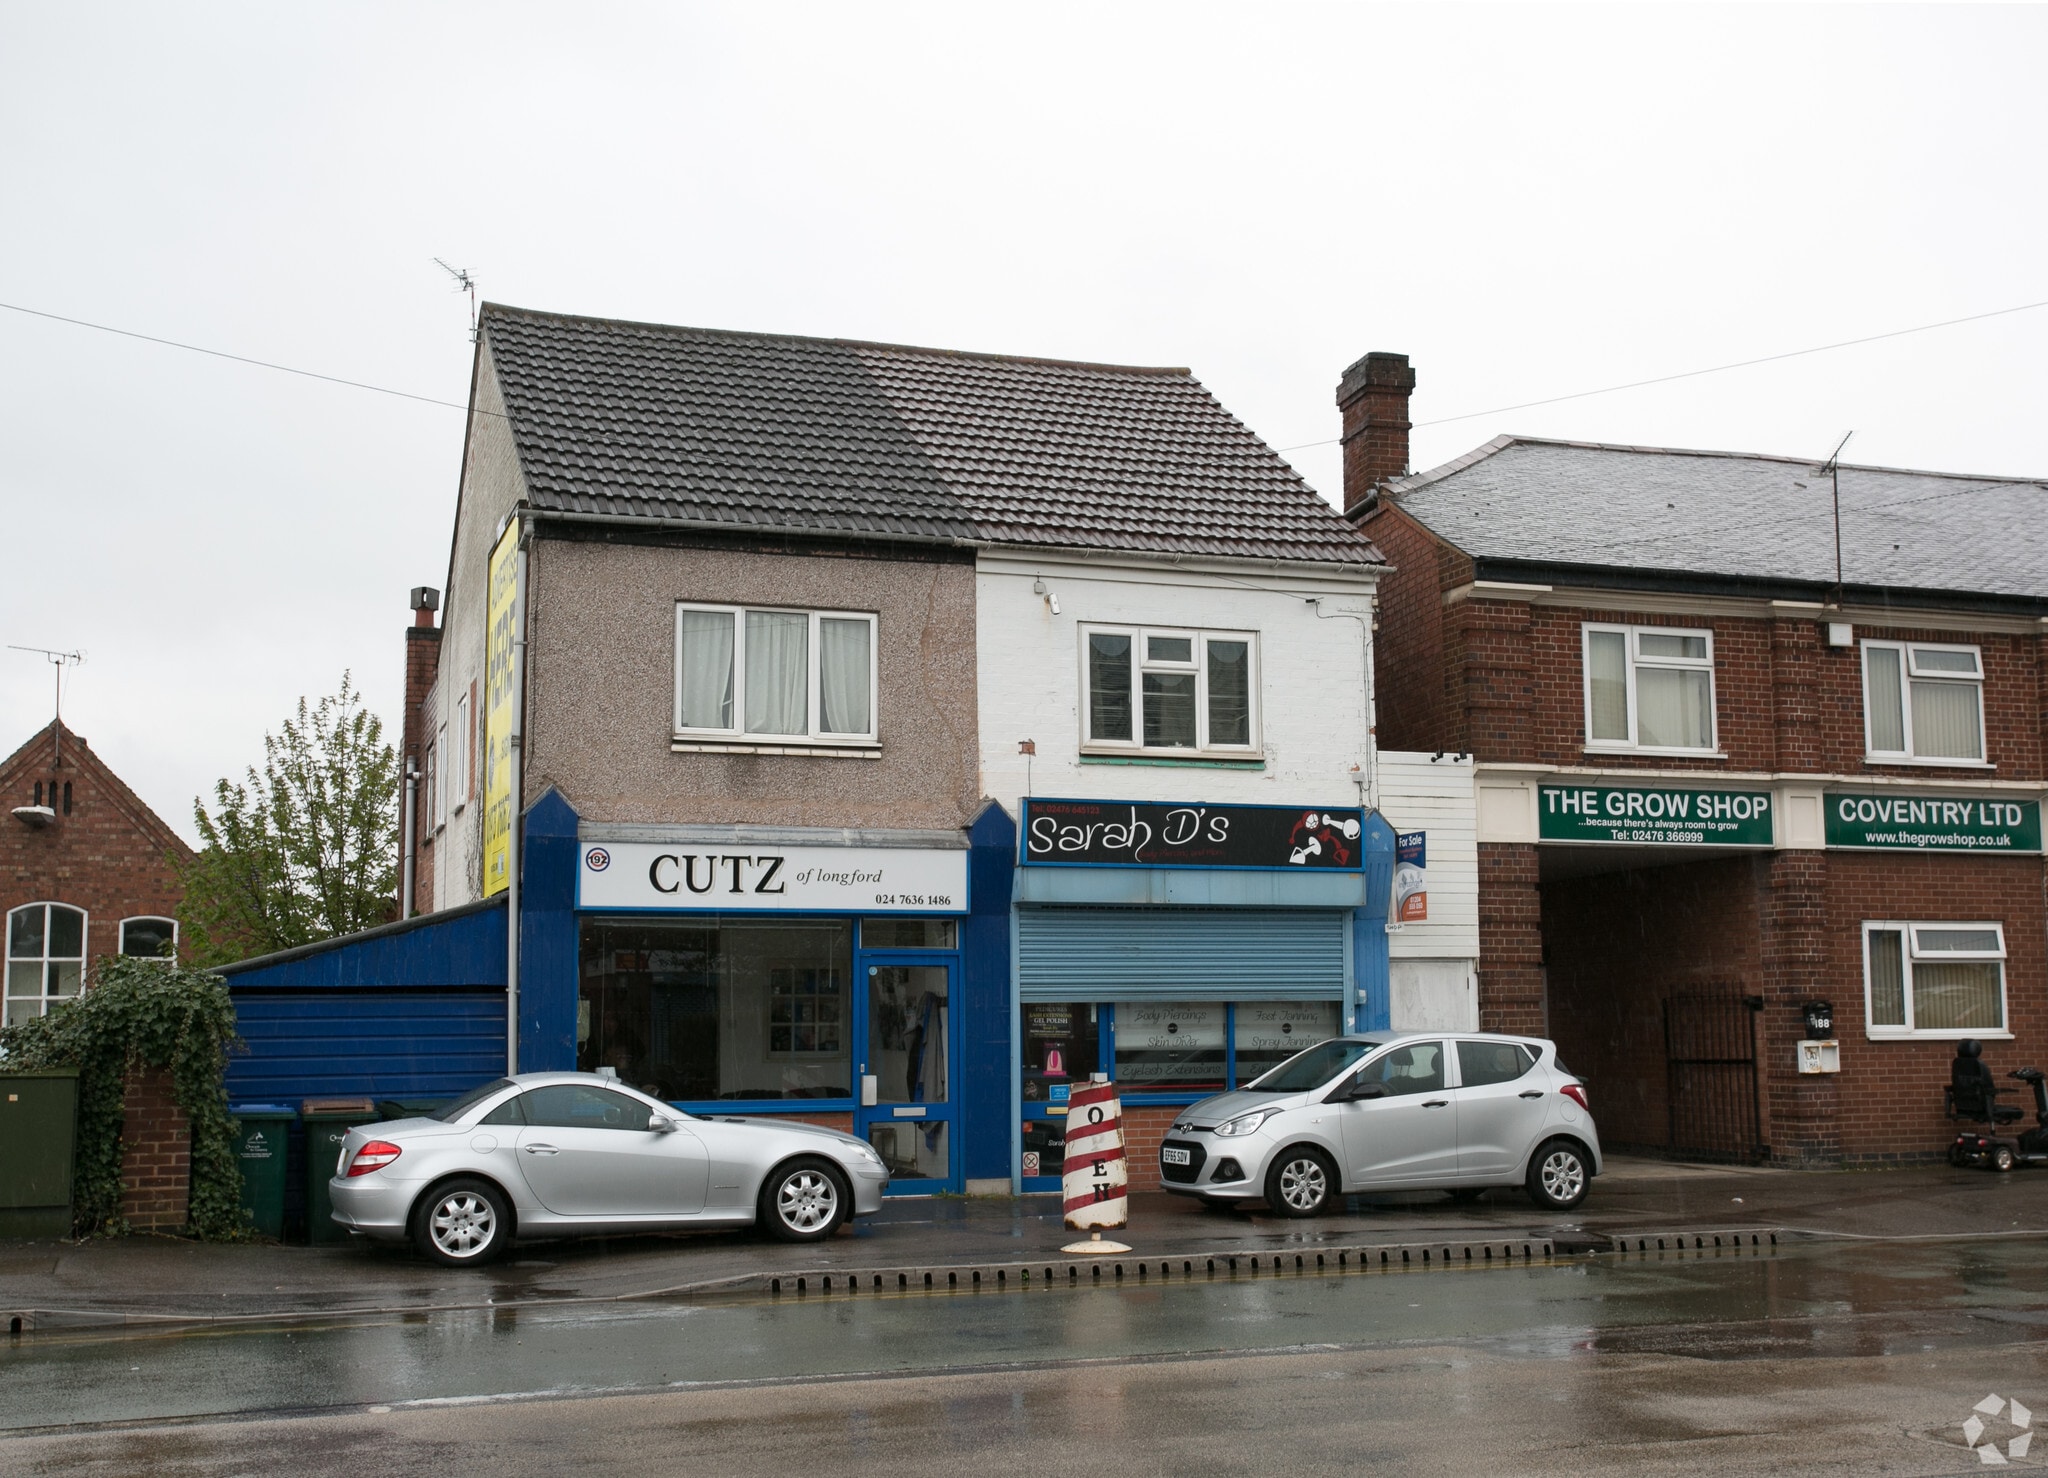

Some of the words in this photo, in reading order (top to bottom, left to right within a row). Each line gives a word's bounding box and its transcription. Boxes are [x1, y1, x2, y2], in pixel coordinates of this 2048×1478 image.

[488, 598, 516, 717] HERE
[1046, 804, 1070, 813] 02476
[1072, 805, 1100, 814] 645123
[1543, 789, 1598, 815] THE
[1605, 791, 1689, 818] GROW
[1696, 794, 1768, 820] SHOP
[1838, 798, 1972, 825] COVENTRY
[1979, 803, 2022, 826] LTD
[1623, 818, 1653, 828] there's
[1654, 819, 1683, 829] always
[1707, 821, 1716, 829] to
[1717, 823, 1739, 832] grow
[1028, 805, 1152, 863] Sarah
[1162, 808, 1229, 845] D's
[1399, 836, 1408, 848] For
[1409, 834, 1422, 846] Sale
[1611, 829, 1630, 841] Tel:
[1632, 830, 1664, 841] 02476
[1666, 831, 1704, 842] 366999
[1865, 831, 2011, 847] www.thegrowshop.co.uk
[588, 855, 608, 864] 192
[649, 854, 786, 895] CUTZ
[796, 868, 814, 885] of
[817, 868, 883, 886] longford
[875, 894, 895, 905] 024
[899, 894, 924, 905] 7636
[928, 895, 951, 905] 1486
[1134, 1009, 1160, 1024] Body
[1162, 1008, 1207, 1024] Piercings
[1255, 1010, 1276, 1021] Fast
[1279, 1009, 1318, 1024] Tanning
[1815, 1018, 1830, 1029] 188
[1147, 1035, 1170, 1049] Skin
[1251, 1036, 1280, 1051] Spray
[1122, 1064, 1163, 1079] Eyelash
[1165, 1062, 1221, 1076] Extensions
[1048, 1139, 1066, 1147] Sarah
[1087, 1106, 1111, 1202] OEN
